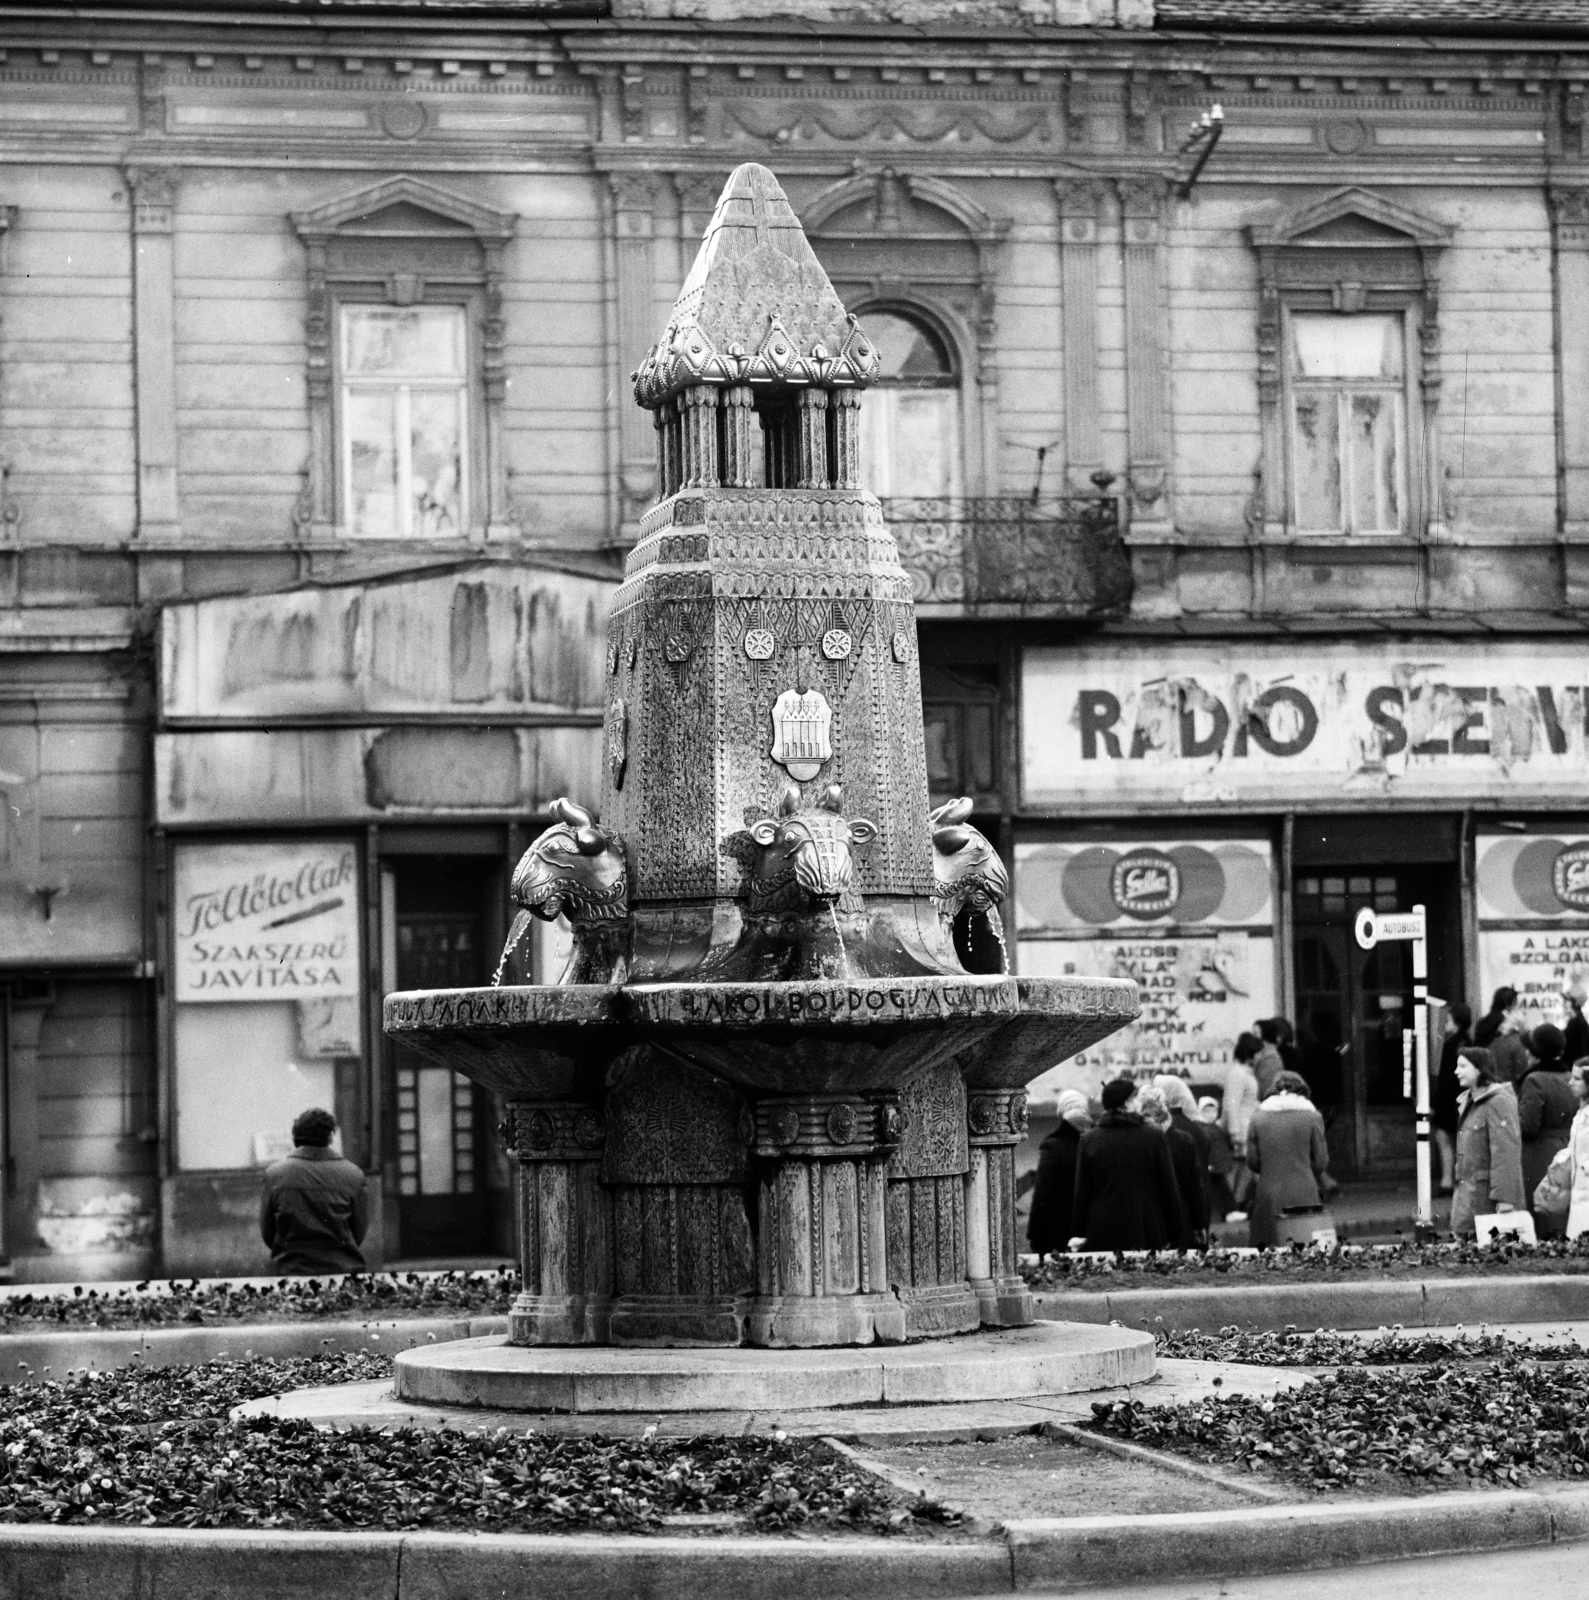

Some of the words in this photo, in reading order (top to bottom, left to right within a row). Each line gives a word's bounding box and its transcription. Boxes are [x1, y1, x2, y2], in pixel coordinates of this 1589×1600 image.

[1382, 920, 1421, 935] AUTOBUSZ
[188, 932, 349, 962] SZAKSZERŰ
[188, 963, 342, 989] JAVÍTÁSA
